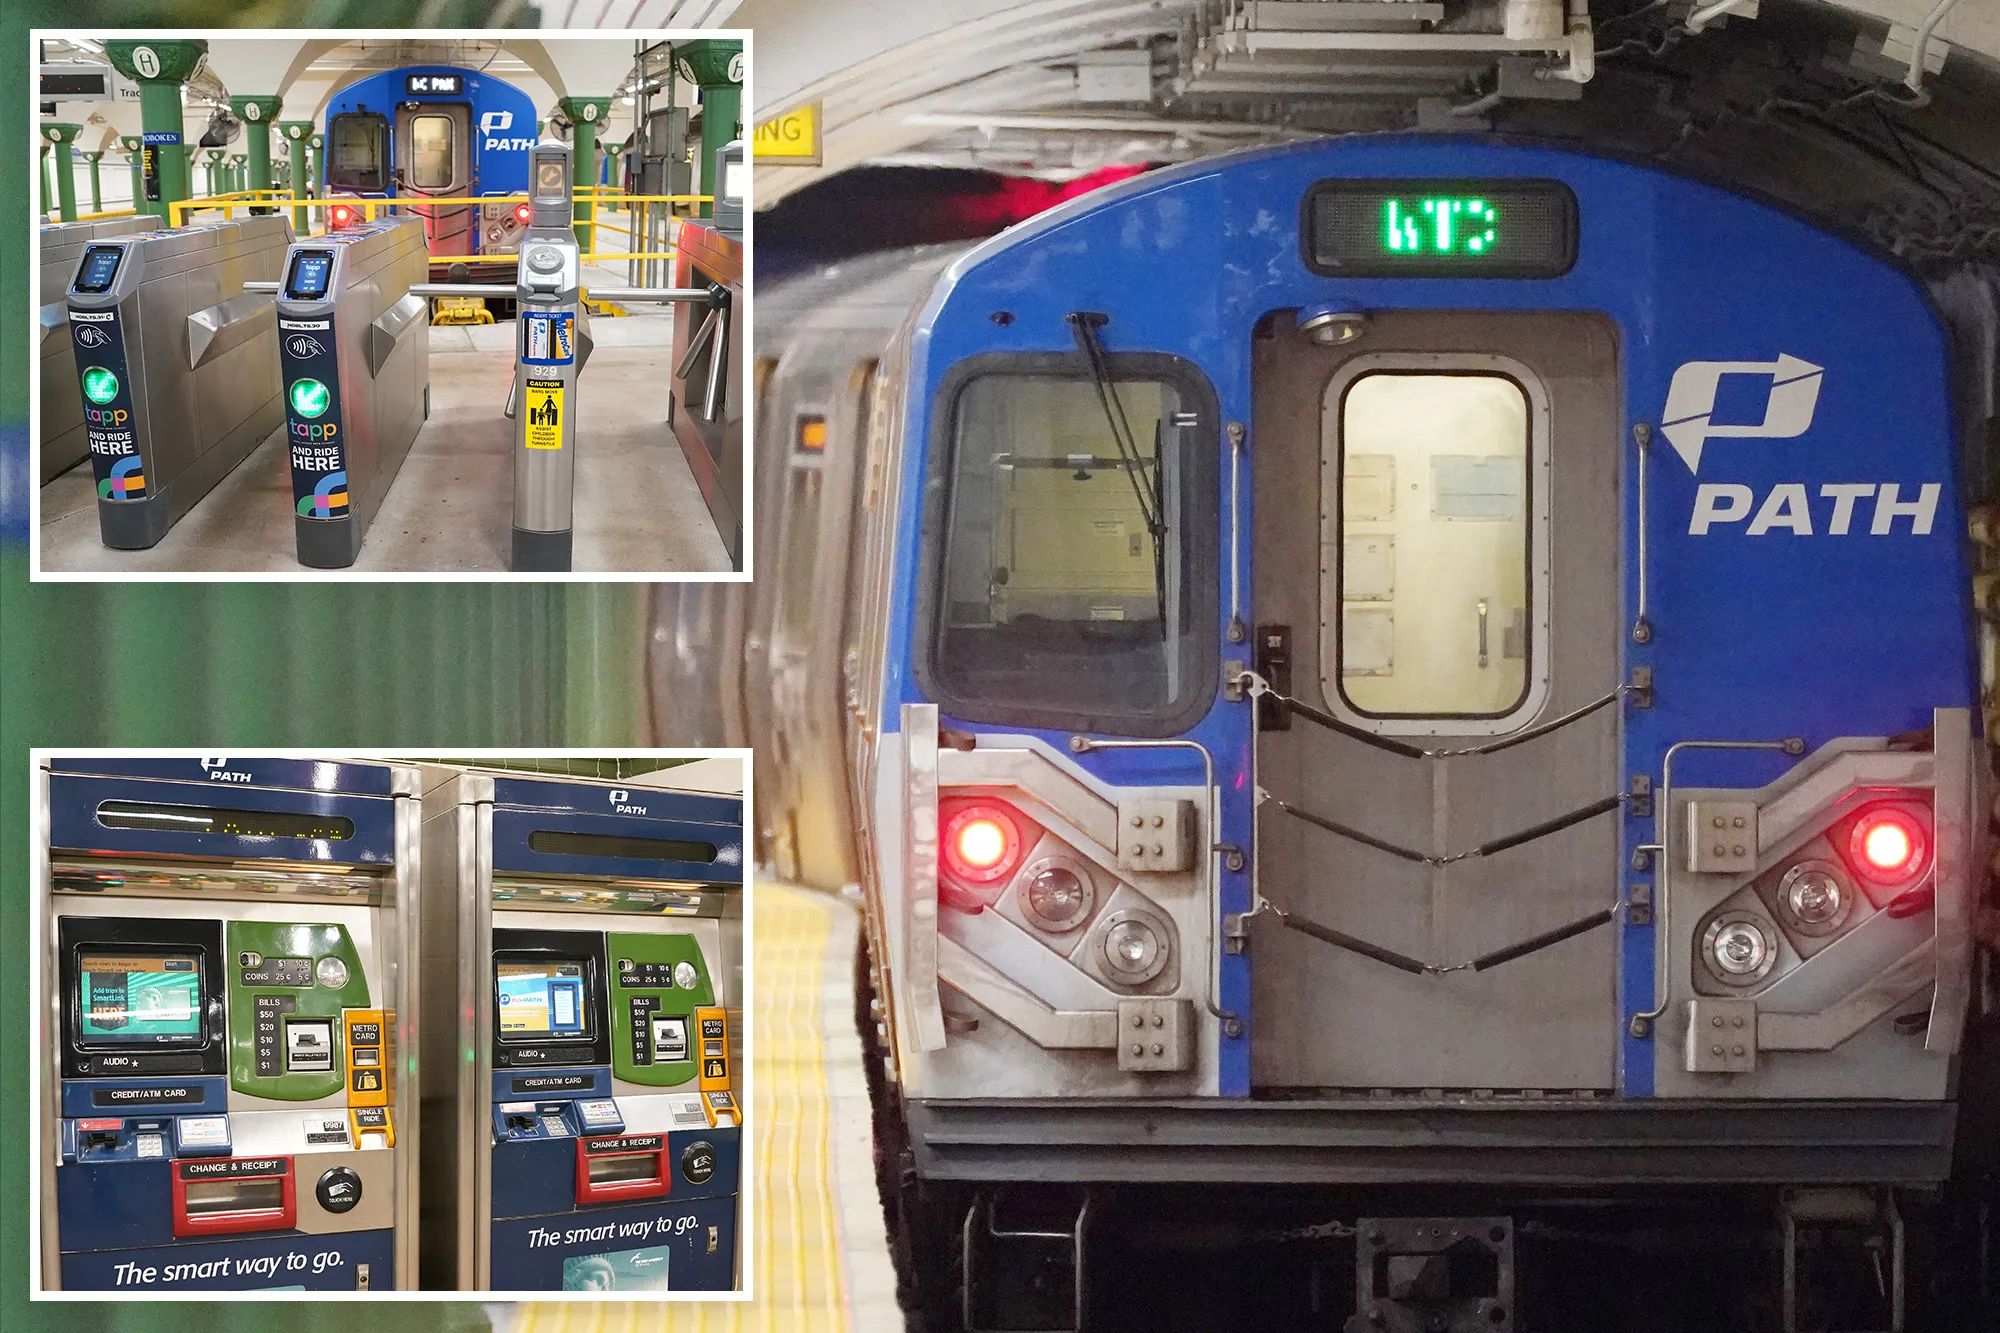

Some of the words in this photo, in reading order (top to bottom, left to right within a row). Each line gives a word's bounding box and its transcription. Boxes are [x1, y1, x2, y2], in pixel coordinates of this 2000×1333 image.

[485, 139, 535, 151] PATH
[534, 366, 558, 376] 929
[85, 404, 128, 426] tapp
[290, 417, 337, 441] tapp
[89, 431, 106, 441] AND
[107, 431, 132, 441] RIDE
[90, 438, 134, 455] HERE
[292, 445, 313, 456] AND
[314, 446, 339, 457] RIDE
[292, 454, 340, 471] HERE
[1688, 483, 1942, 535] PATH
[210, 770, 252, 783] PATH
[616, 804, 647, 815] PATH
[260, 1023, 274, 1031] $20
[103, 1058, 129, 1066] AUDIO
[261, 1061, 270, 1069] $1
[111, 1090, 161, 1099] CREDIT/ATM
[164, 1089, 186, 1097] CARD
[591, 1140, 619, 1149] CHANGE
[622, 1139, 627, 1147] &
[630, 1137, 656, 1146] RECEIPT
[190, 1163, 227, 1173] CHANGE
[231, 1163, 237, 1171] &
[241, 1161, 278, 1170] RECEIPT
[528, 1228, 560, 1248] The
[564, 1222, 616, 1244] smart
[619, 1220, 656, 1240] way
[656, 1216, 673, 1232] to
[675, 1215, 699, 1235] go.
[113, 1261, 157, 1286] The
[162, 1258, 231, 1281] smart
[235, 1256, 282, 1278] way
[285, 1252, 307, 1270] to
[311, 1250, 344, 1274] go.
